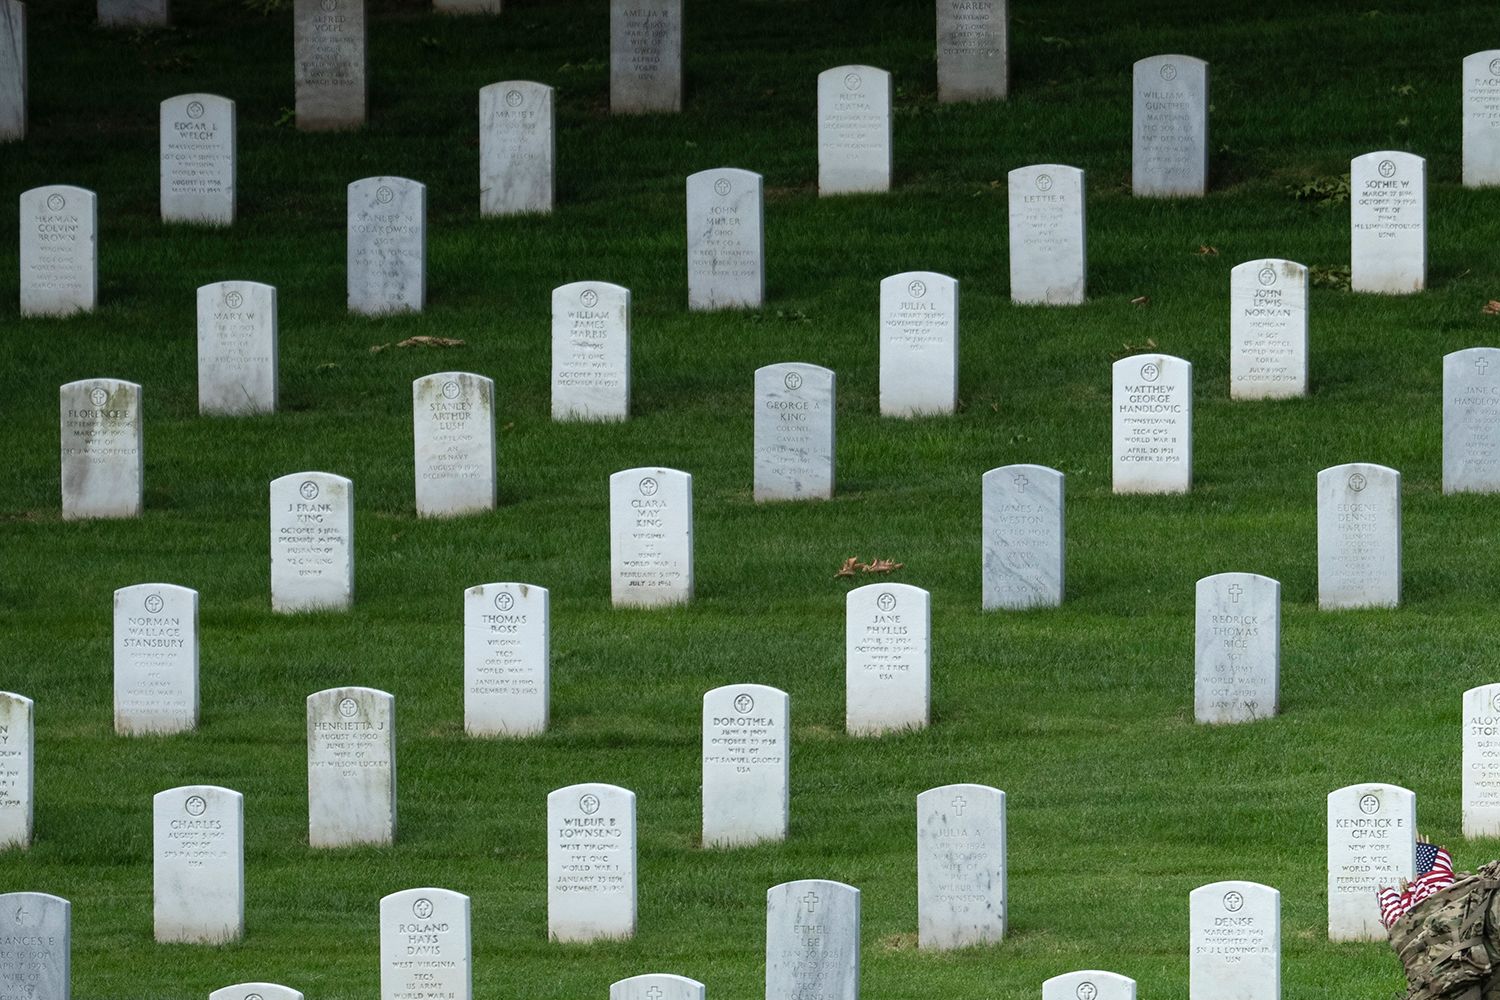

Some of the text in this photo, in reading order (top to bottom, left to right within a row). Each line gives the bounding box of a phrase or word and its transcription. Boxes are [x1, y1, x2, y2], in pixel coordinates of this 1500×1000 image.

[174, 122, 206, 130] EDGAR
[180, 132, 213, 140] WELCH
[1255, 289, 1282, 298] JOHN
[1253, 299, 1282, 307] LEWIS
[1125, 385, 1175, 393] MATTHEW
[1129, 394, 1170, 403] GEORGE
[766, 401, 808, 410] GEORGE
[1119, 405, 1181, 413] HANDLOVIC
[780, 413, 806, 421] KING
[1337, 503, 1376, 512] EUGENE
[1338, 512, 1376, 522] DENNIS
[1338, 523, 1377, 532] HARRIS
[128, 617, 180, 625] NORMAN
[483, 615, 527, 623] THOMAS
[128, 628, 180, 637] WALLACE
[124, 638, 184, 648] STANSBURY
[170, 819, 222, 829] CHARLES
[1336, 818, 1403, 828] KENDRICK E
[1351, 829, 1387, 839] CHASE
[399, 923, 449, 933] ROLAND
[1214, 919, 1253, 928] DENISE
[408, 934, 439, 944] HAYS
[407, 945, 440, 955] DAVIS
